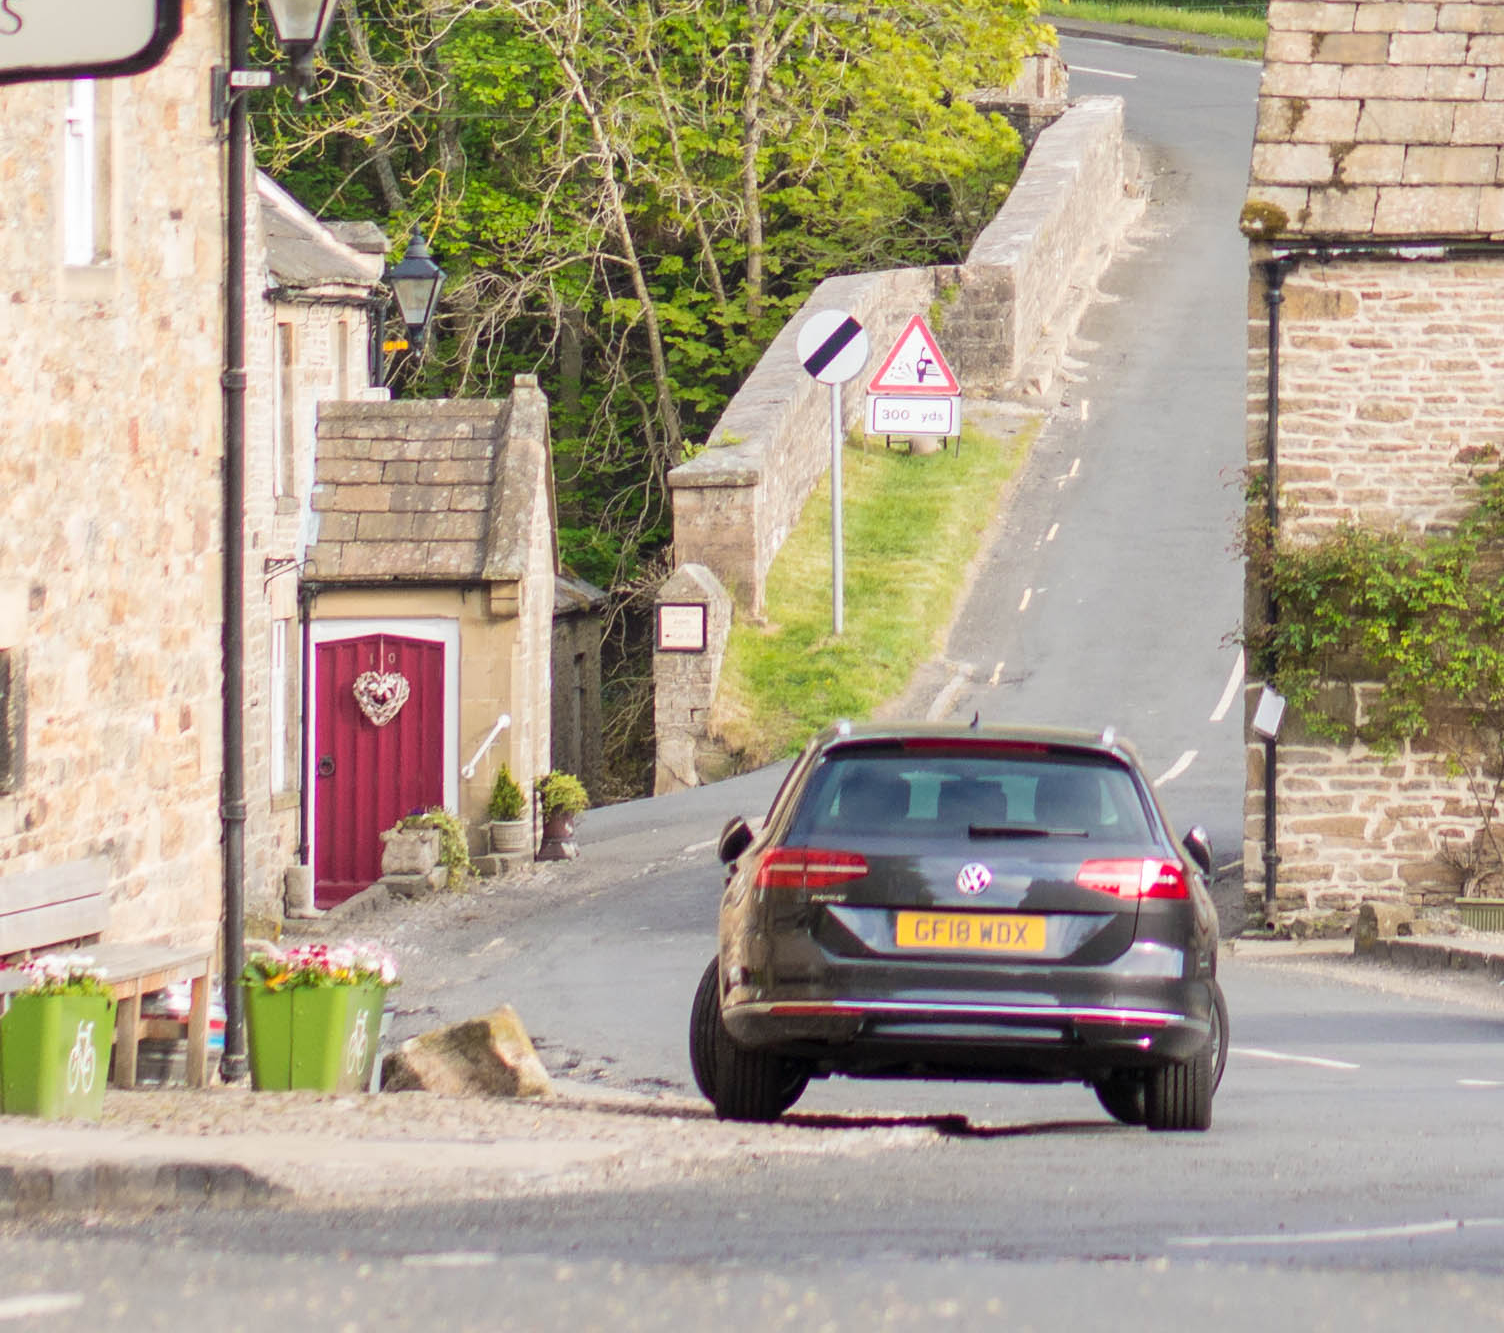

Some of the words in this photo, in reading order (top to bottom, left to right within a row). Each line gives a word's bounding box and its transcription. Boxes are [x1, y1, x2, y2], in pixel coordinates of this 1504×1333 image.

[881, 408, 911, 421] 300
[921, 410, 944, 424] yds
[914, 918, 971, 943] GF18
[979, 922, 1029, 945] WDX
